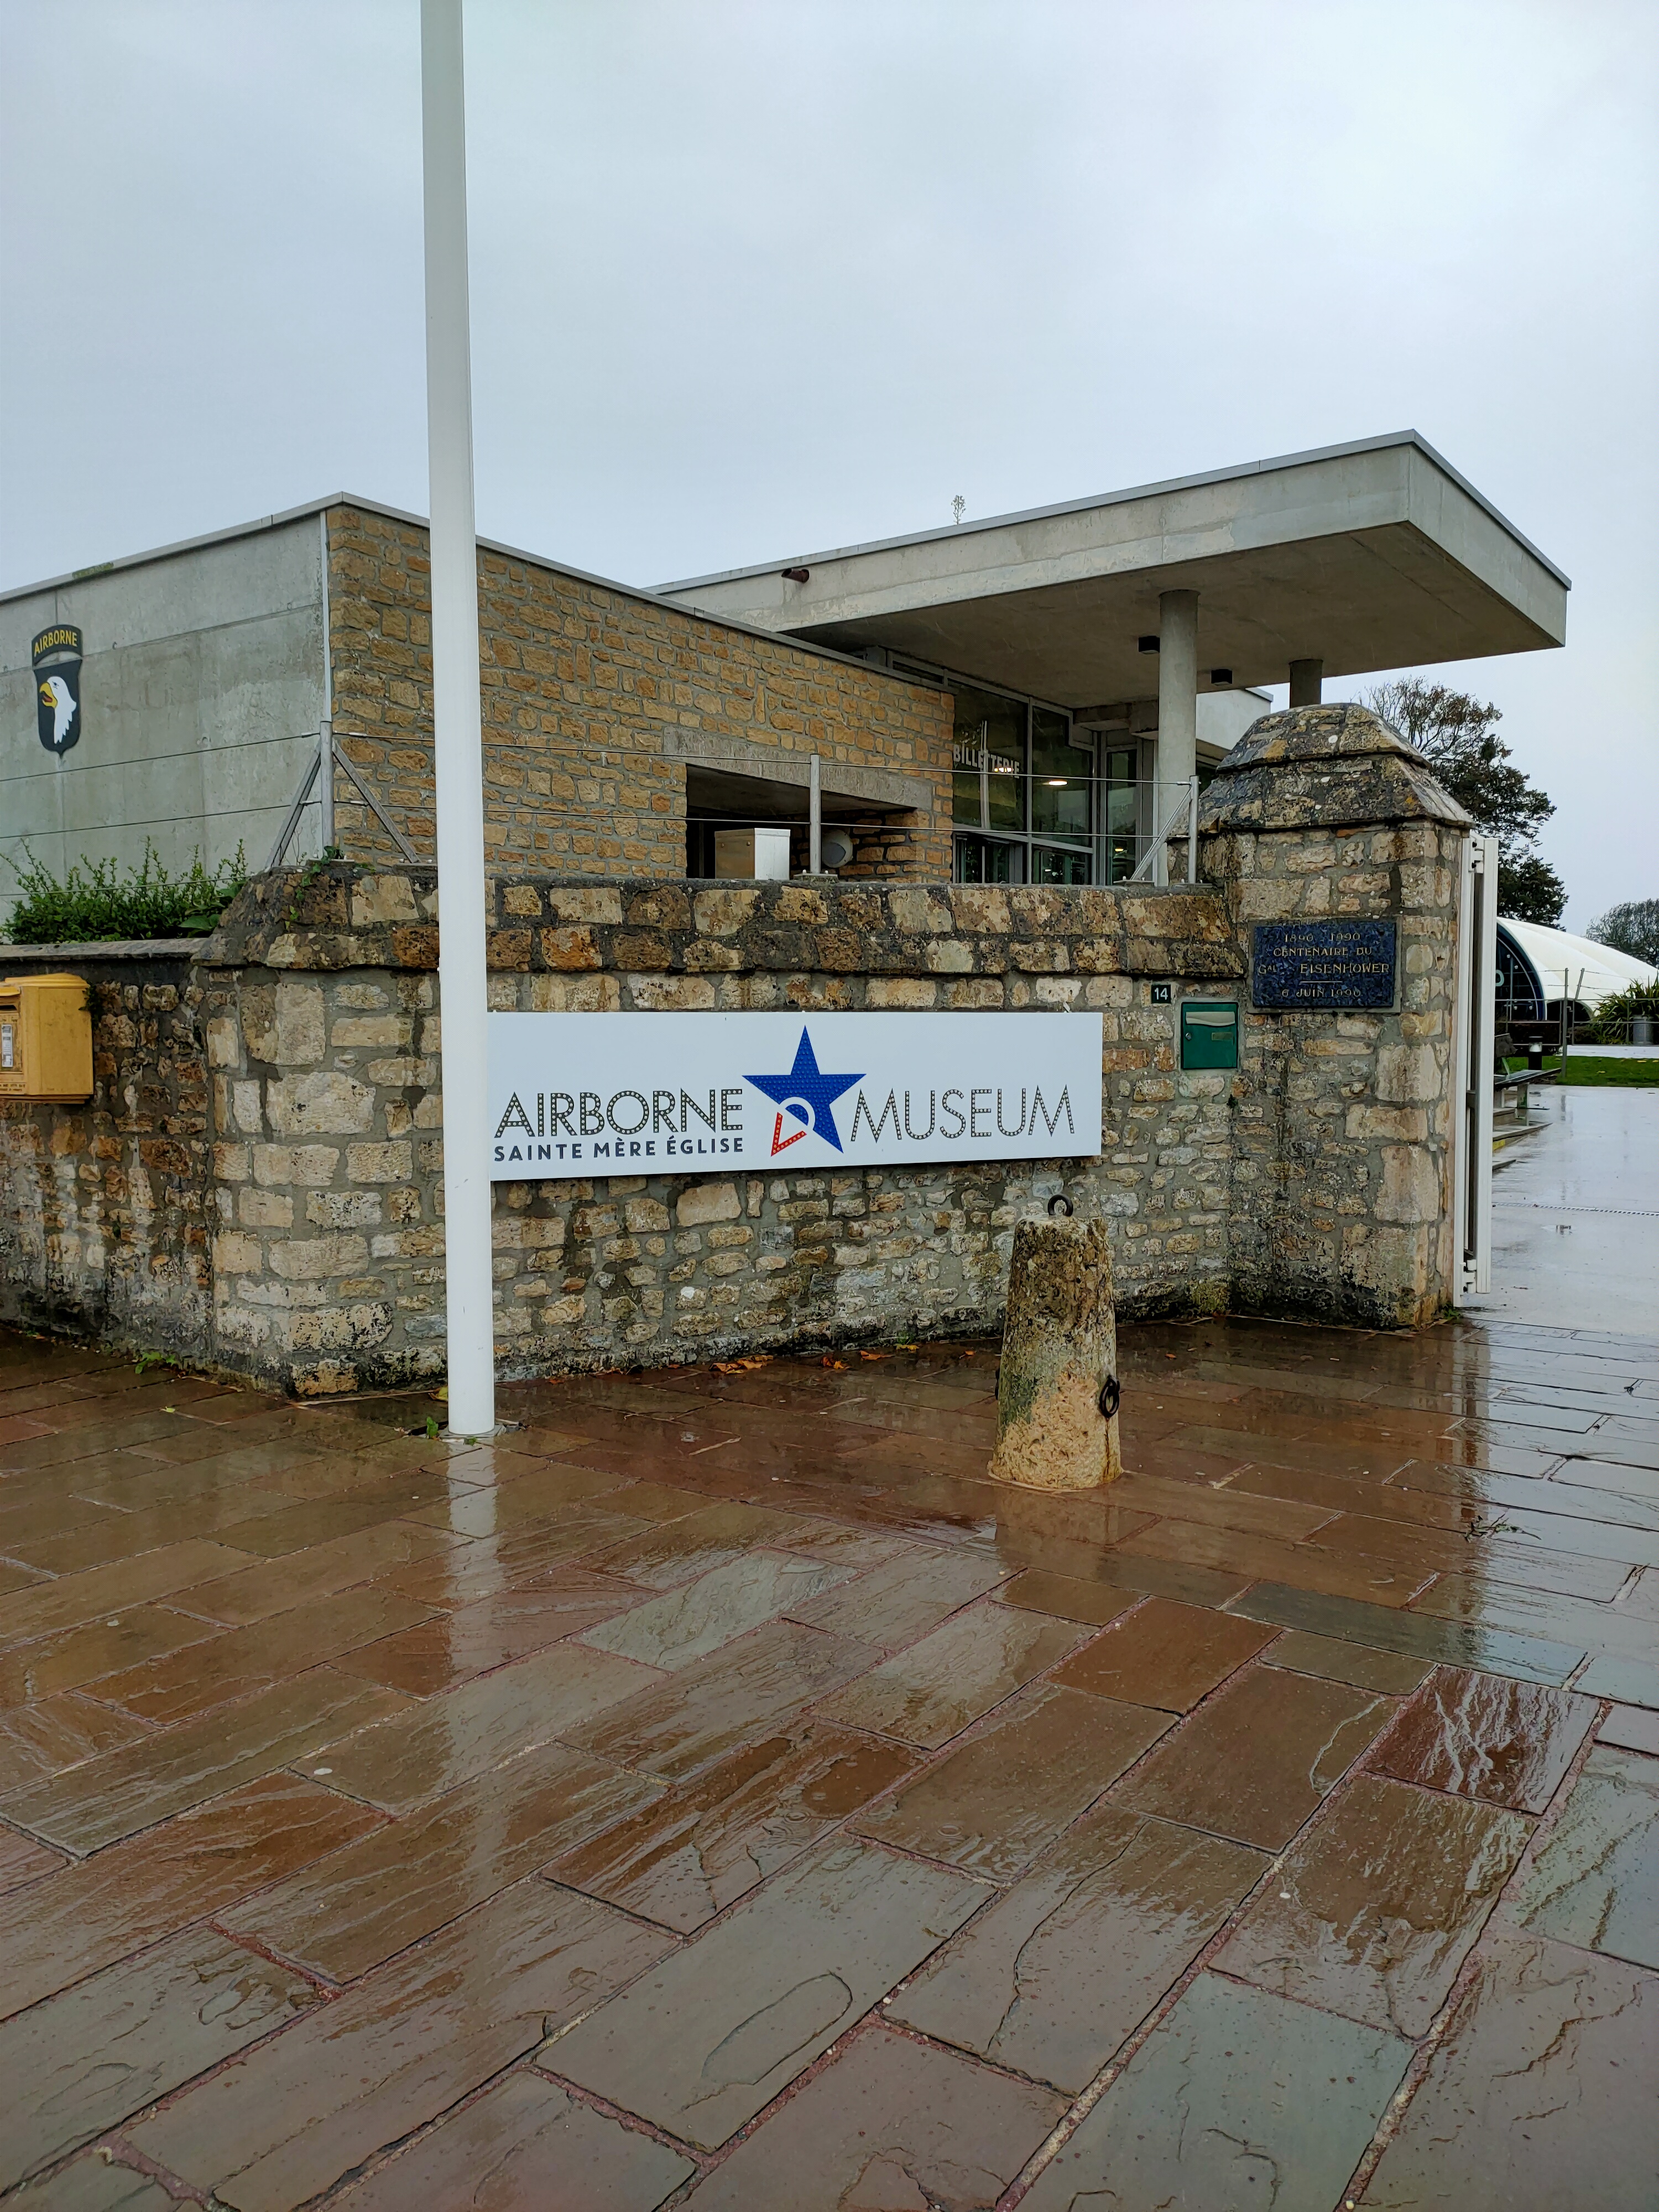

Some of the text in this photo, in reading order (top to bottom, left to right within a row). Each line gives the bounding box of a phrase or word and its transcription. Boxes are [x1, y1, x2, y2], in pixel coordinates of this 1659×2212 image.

[34, 629, 78, 658] AIRBORNE
[1330, 932, 1361, 941] 1990
[1273, 946, 1373, 957] CENTENAIRE DU
[1300, 962, 1390, 974] EISENHOWER
[1154, 987, 1168, 1000] 14
[1282, 988, 1361, 998] 6 JUIN 1990
[494, 1084, 1075, 1144] AIRBORNE MUSEUM
[494, 1135, 743, 1162] SAINTE MÈRE ÉGLISE
